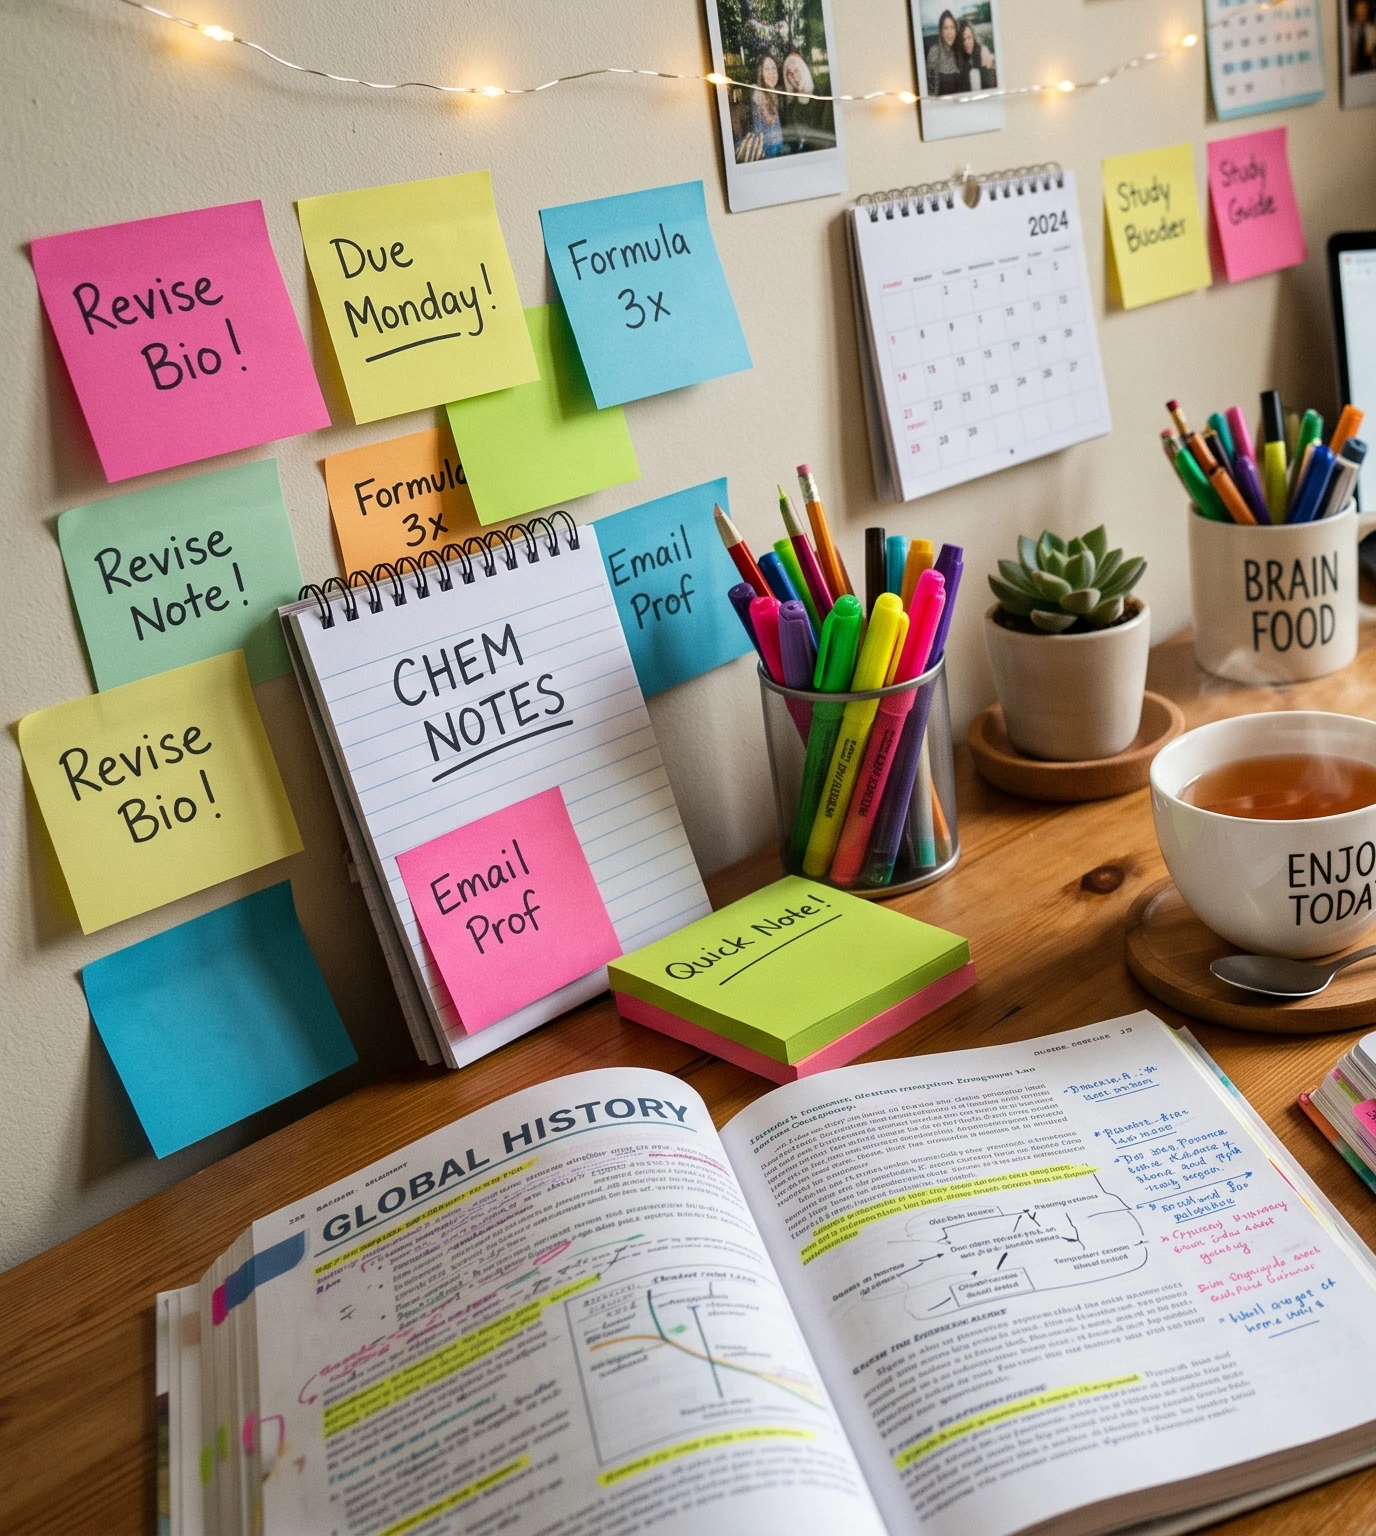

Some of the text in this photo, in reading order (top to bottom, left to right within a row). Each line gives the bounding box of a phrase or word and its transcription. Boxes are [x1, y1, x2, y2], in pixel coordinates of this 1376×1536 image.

[1116, 177, 1171, 214] Study
[1219, 155, 1267, 197] Study
[568, 222, 691, 281] Formula
[1028, 210, 1069, 237] 2024
[330, 236, 415, 280] Due
[72, 271, 224, 336] Revise
[344, 263, 498, 339] Monday!
[617, 287, 672, 330] 3x
[402, 510, 450, 548] 3x
[608, 524, 694, 588] Email
[94, 528, 233, 595] Revise
[1244, 552, 1339, 601] BRAIN
[631, 573, 696, 629] Prof
[1252, 606, 1335, 652] FOOD
[392, 624, 525, 707] CHEM
[423, 672, 566, 763] NOTES
[58, 724, 213, 801] Revise
[430, 838, 530, 916] Email
[465, 889, 542, 954] Prof
[665, 894, 832, 980] Quick Note!
[321, 1147, 491, 1243] GLOBAL
[502, 1096, 690, 1154] HISTORY
